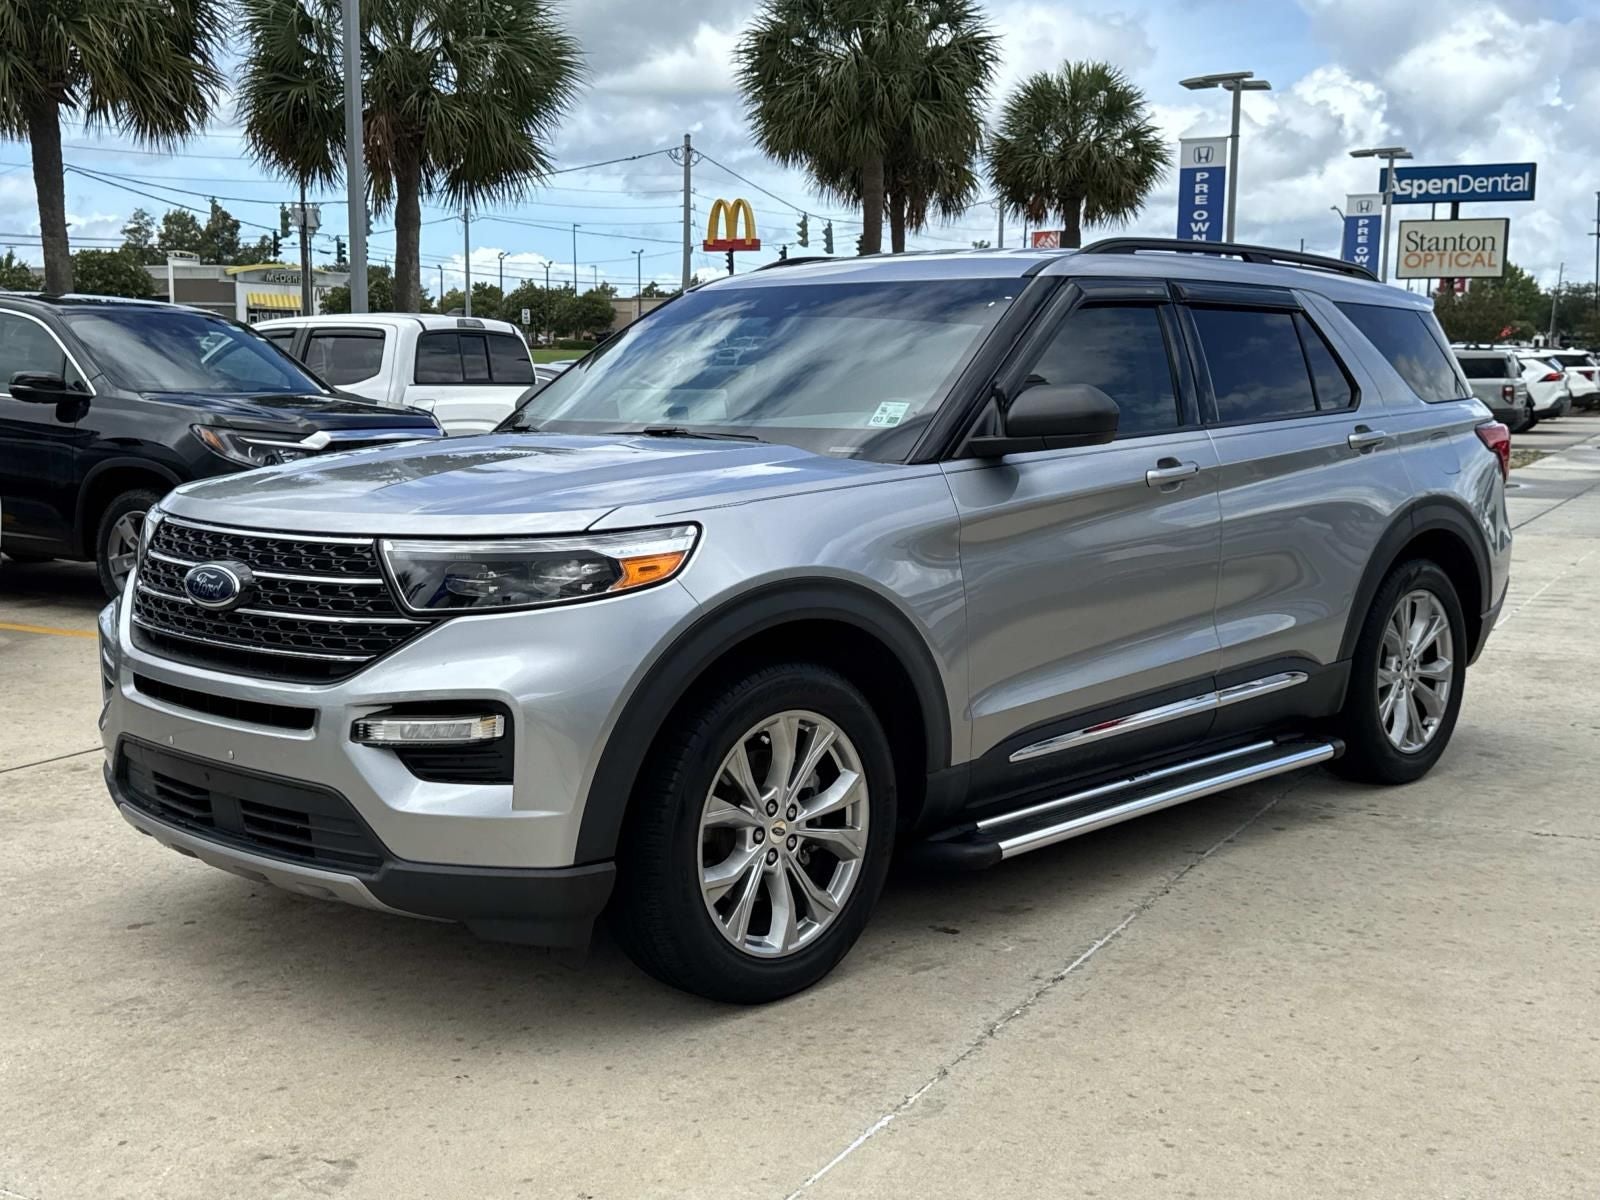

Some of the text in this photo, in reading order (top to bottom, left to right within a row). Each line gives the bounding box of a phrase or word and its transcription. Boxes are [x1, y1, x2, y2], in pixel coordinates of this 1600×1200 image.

[1194, 172, 1209, 205] PRE
[1354, 218, 1370, 268] PRE OW
[1405, 230, 1496, 252] Stanton
[1404, 252, 1497, 269] OPTICAL
[193, 572, 224, 597] Ford
